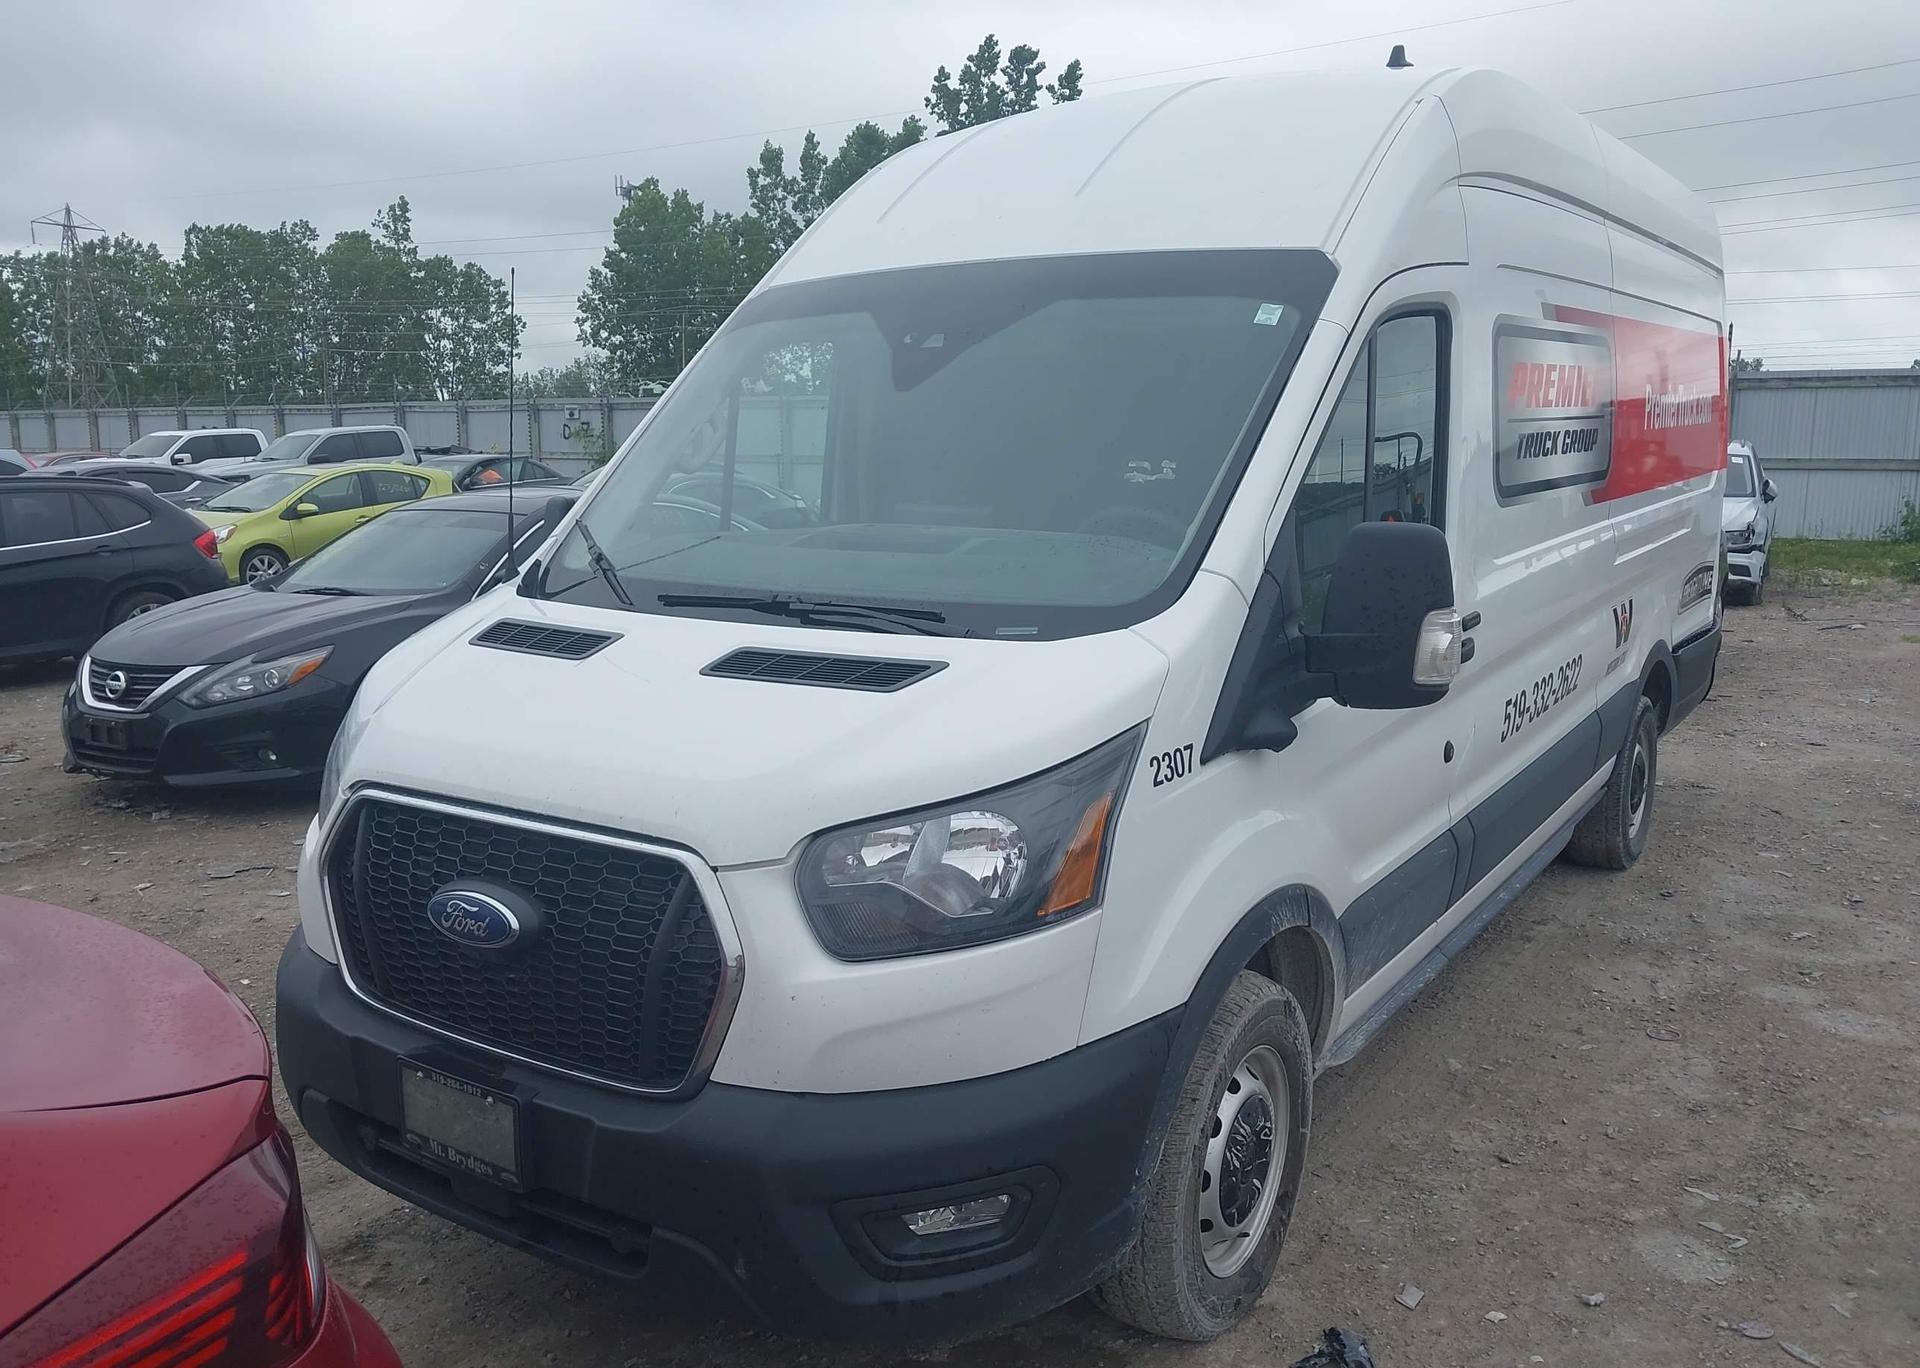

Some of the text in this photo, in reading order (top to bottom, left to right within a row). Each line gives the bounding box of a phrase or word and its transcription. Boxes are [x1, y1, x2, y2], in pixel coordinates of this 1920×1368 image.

[1516, 428, 1598, 460] TRUCK GROUP
[1501, 654, 1582, 743] 519-332-2622
[1149, 743, 1193, 787] 2307
[441, 900, 489, 937] Ford
[448, 1147, 493, 1176] Brydges
